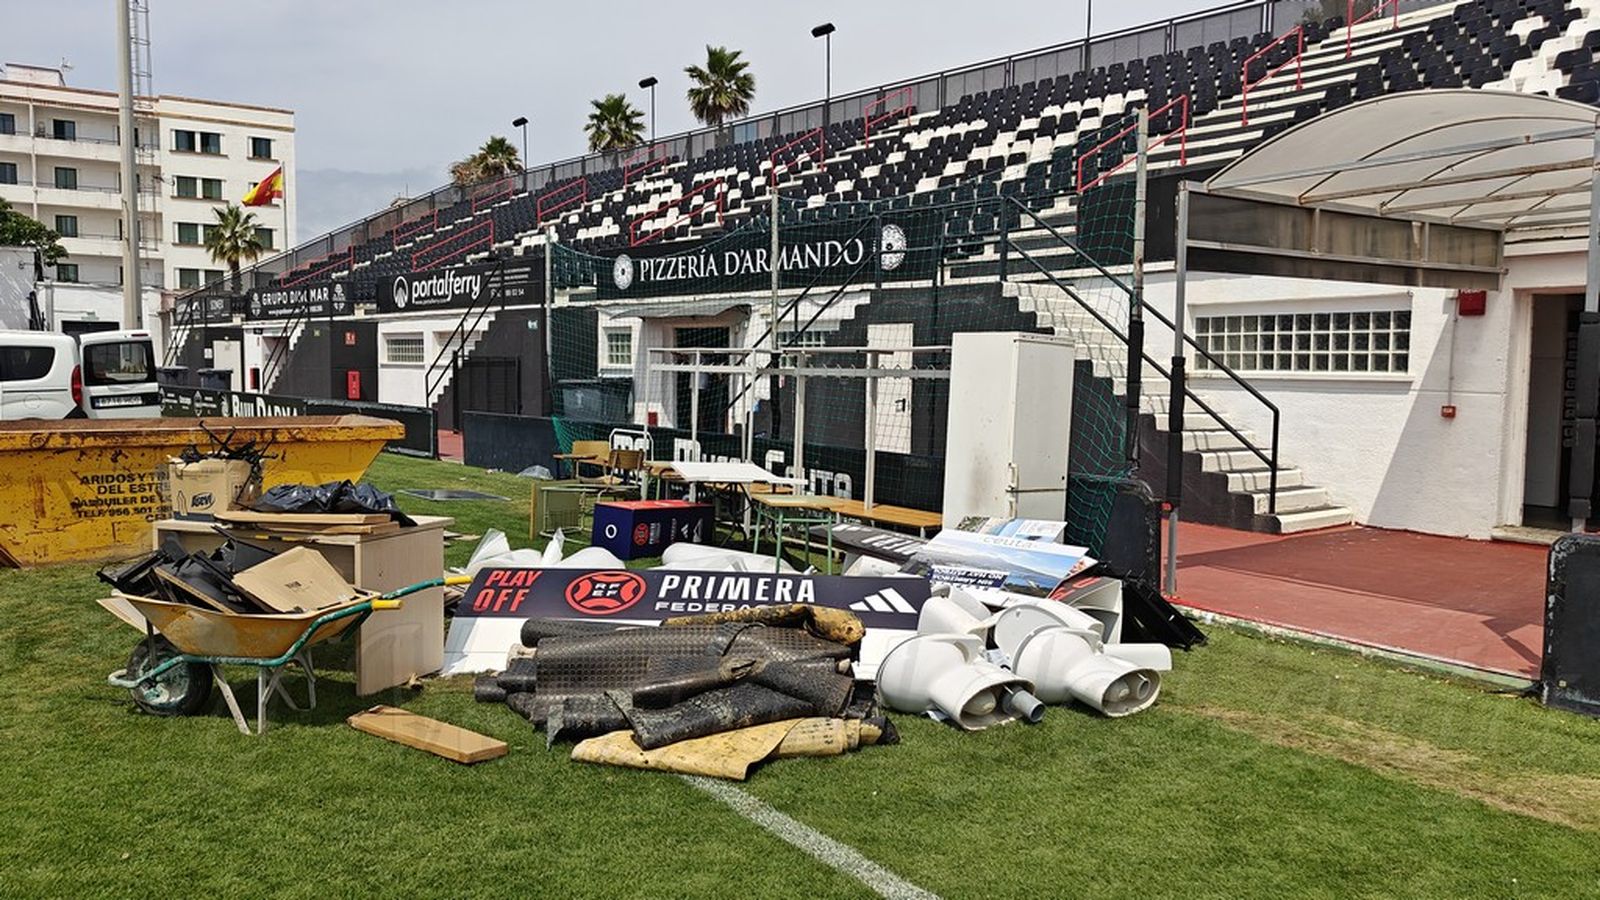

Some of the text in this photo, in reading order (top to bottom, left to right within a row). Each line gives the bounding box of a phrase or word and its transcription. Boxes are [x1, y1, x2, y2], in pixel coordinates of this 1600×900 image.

[640, 249, 719, 282] PIZZERÍA
[262, 292, 288, 306] GRUPO
[310, 287, 329, 302] MAR
[411, 269, 481, 304] portalferry
[80, 473, 136, 485] ARIDOS
[97, 485, 125, 495] DEL
[485, 570, 543, 587] PLAY
[658, 575, 816, 603] PRIMERA
[473, 588, 530, 612] OFF
